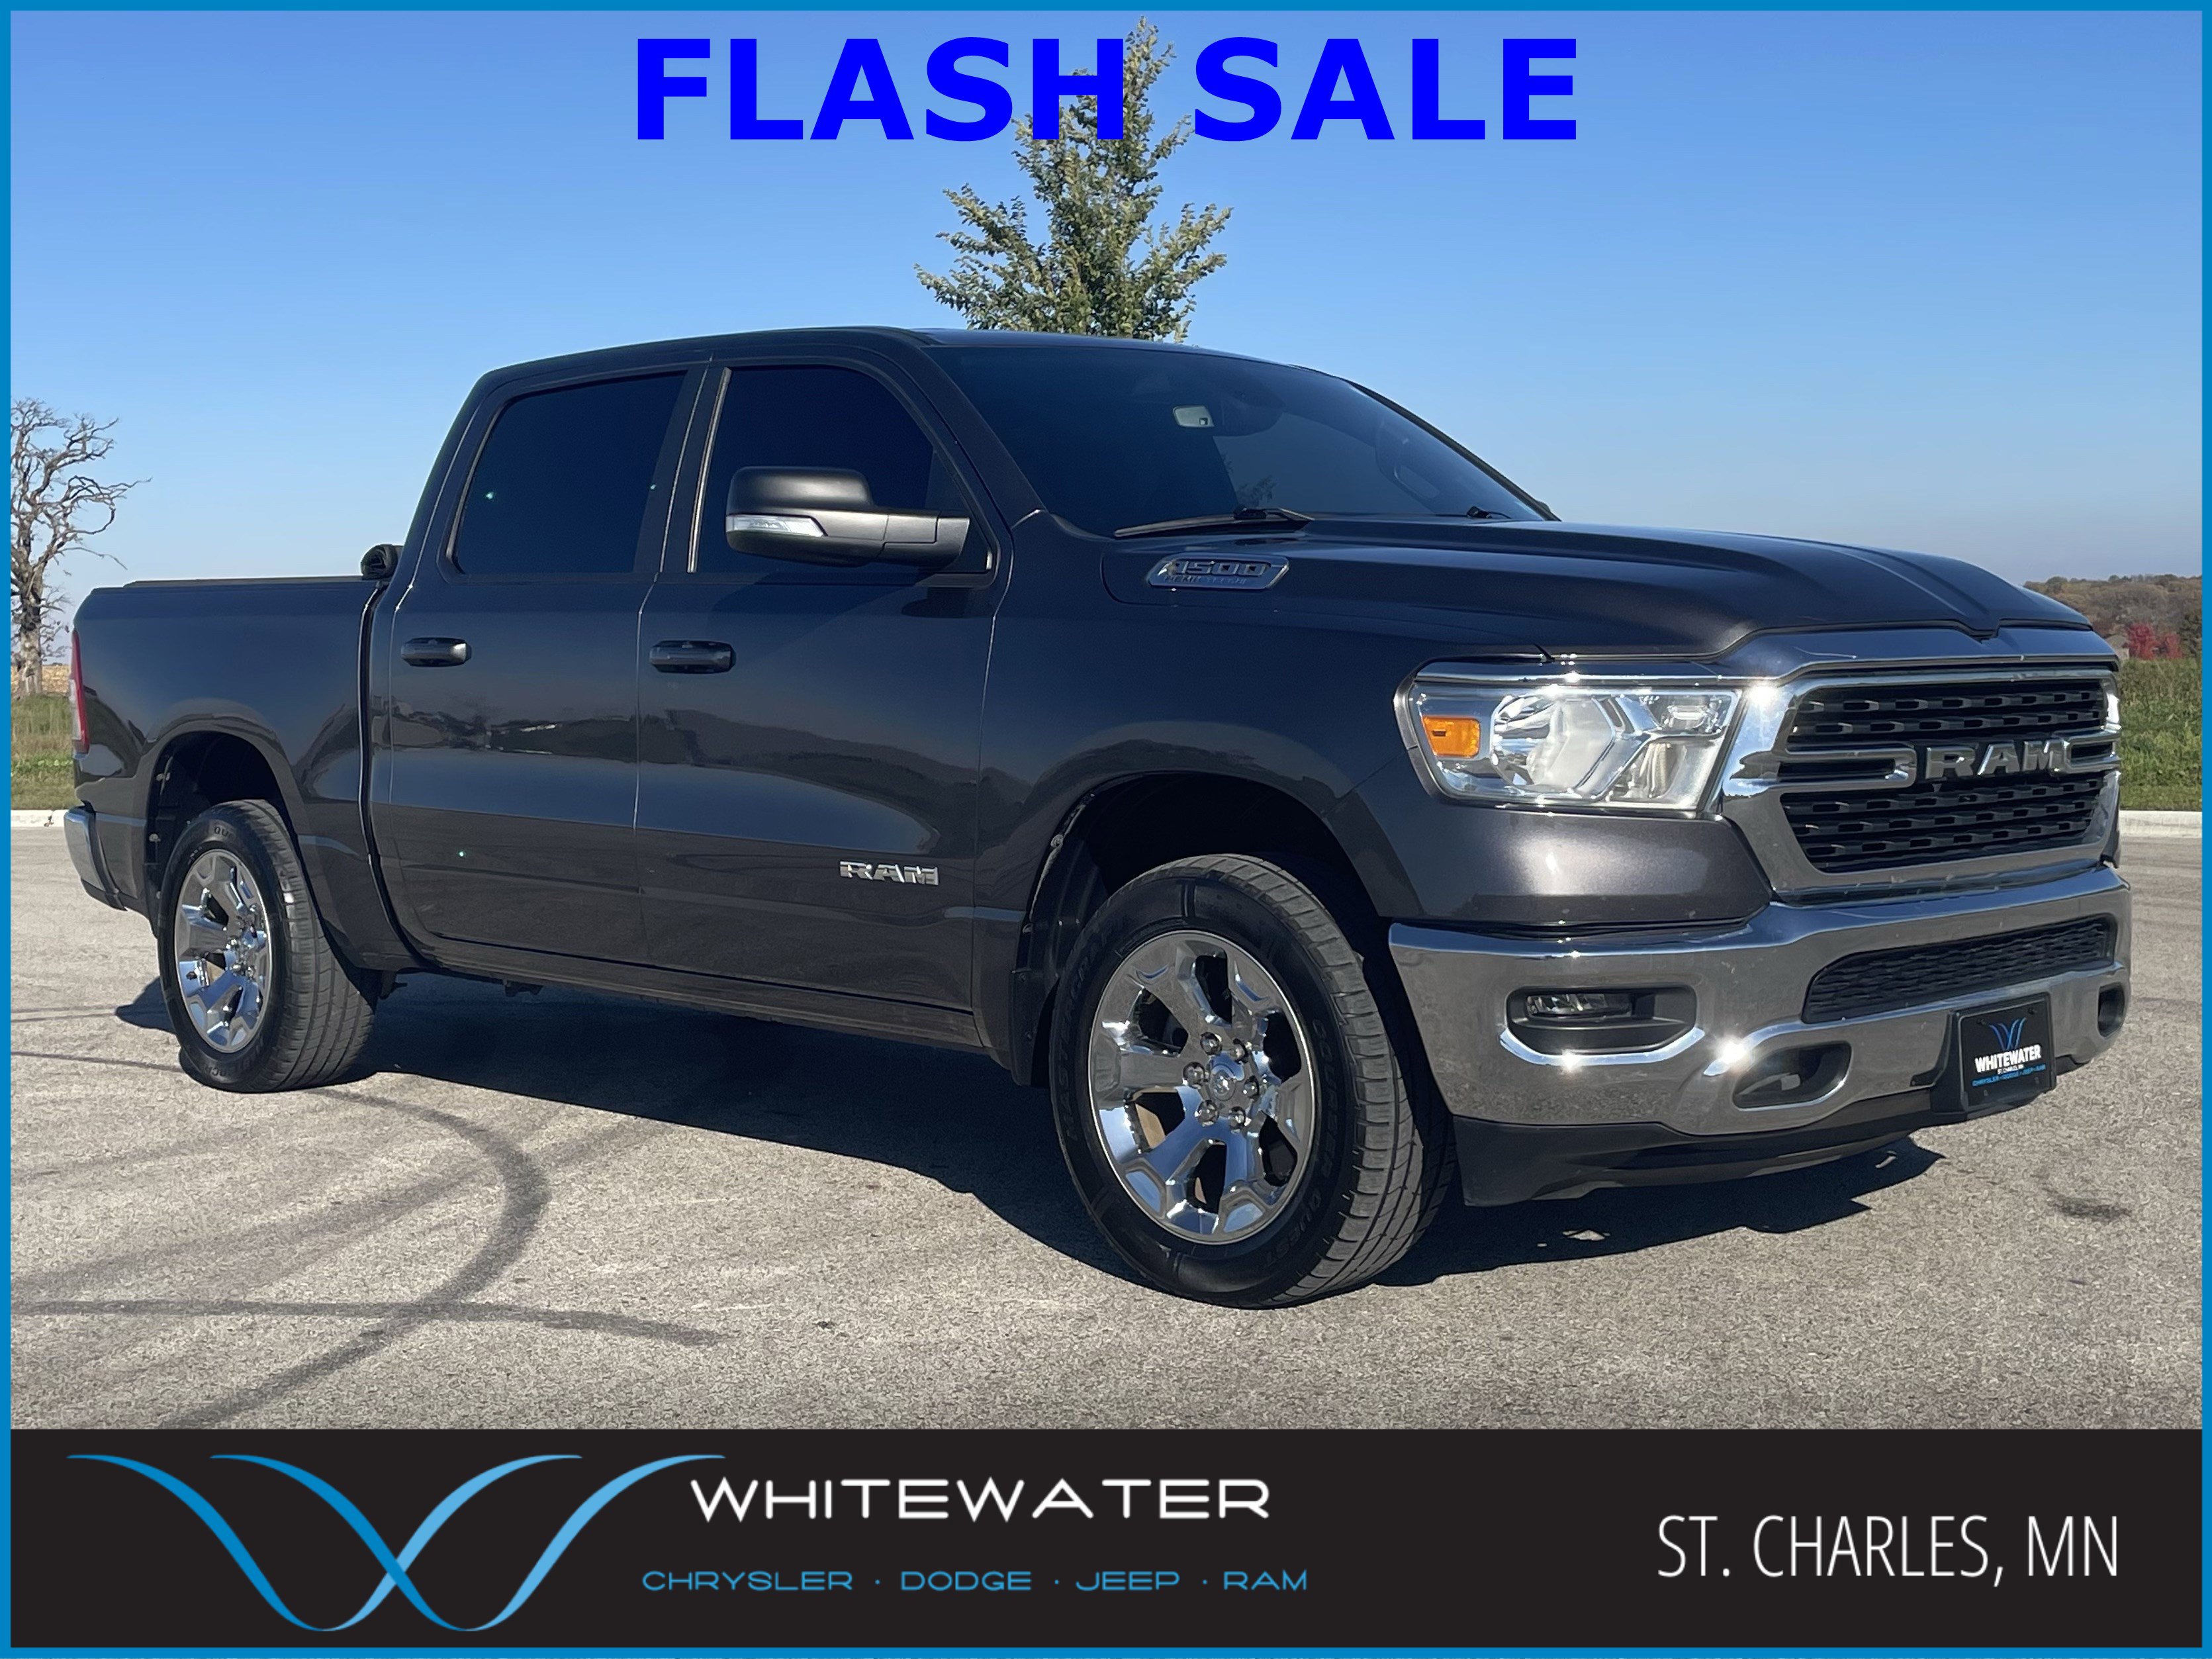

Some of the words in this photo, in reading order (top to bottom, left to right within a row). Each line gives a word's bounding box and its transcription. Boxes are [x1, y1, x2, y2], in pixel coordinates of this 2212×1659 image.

[1925, 738, 2066, 780] RAM
[839, 861, 939, 886] RAM
[1974, 1044, 2042, 1072] WHITEWATER
